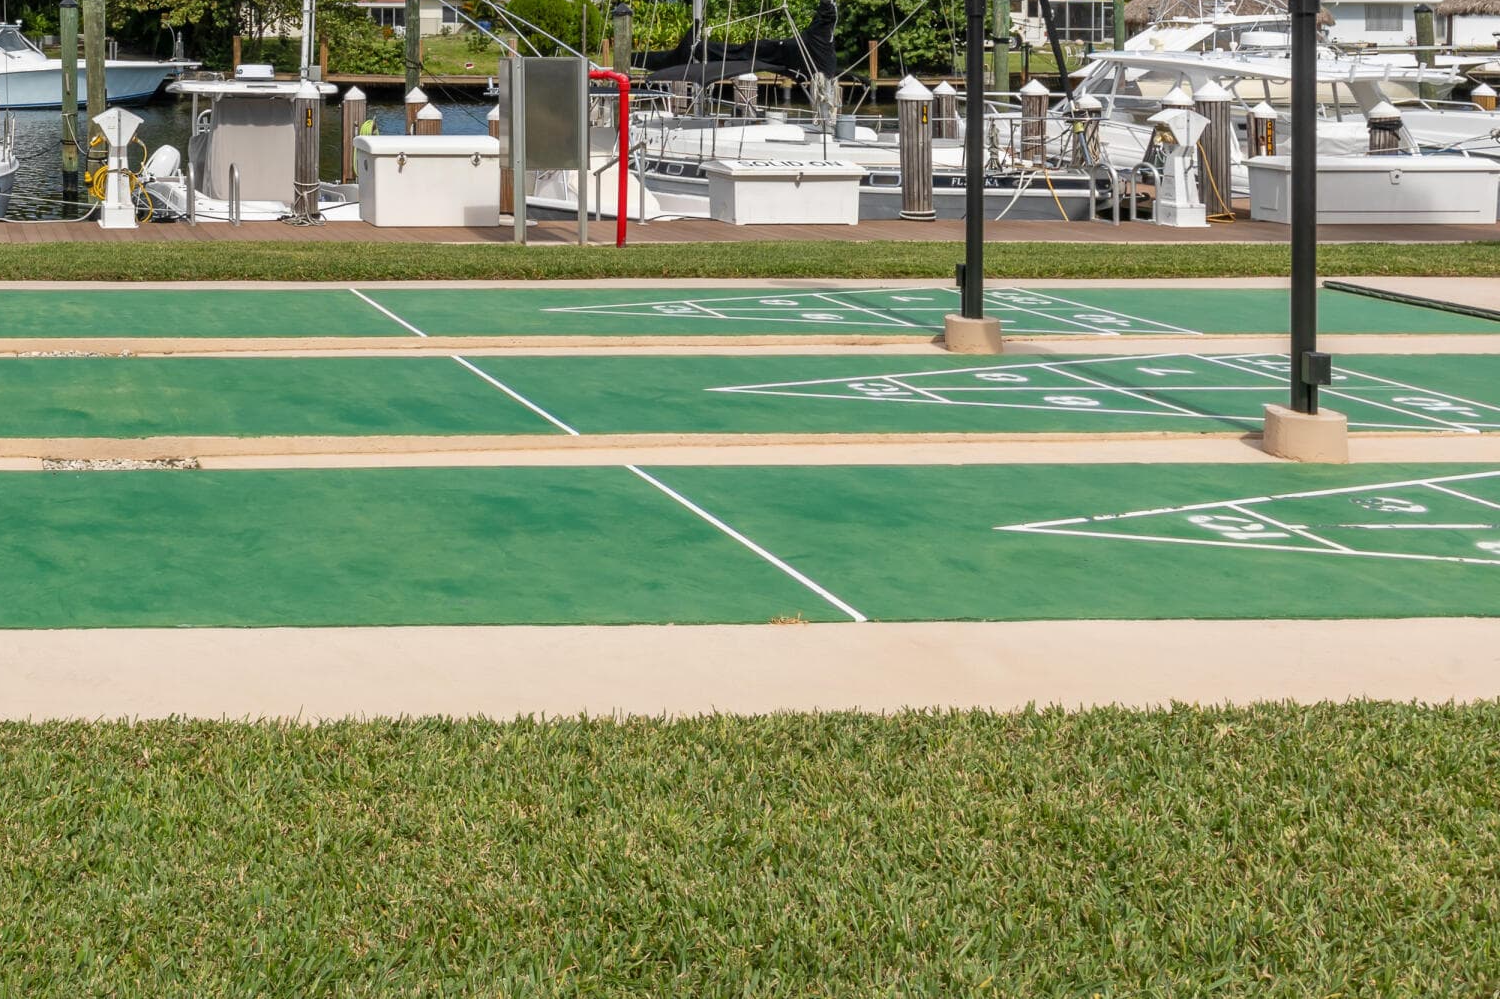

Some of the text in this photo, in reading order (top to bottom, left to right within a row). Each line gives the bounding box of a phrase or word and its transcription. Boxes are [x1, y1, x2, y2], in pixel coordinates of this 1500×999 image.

[306, 108, 313, 127] 13
[921, 104, 928, 124] 14
[737, 160, 804, 168] SOLID
[1187, 514, 1291, 540] 10
